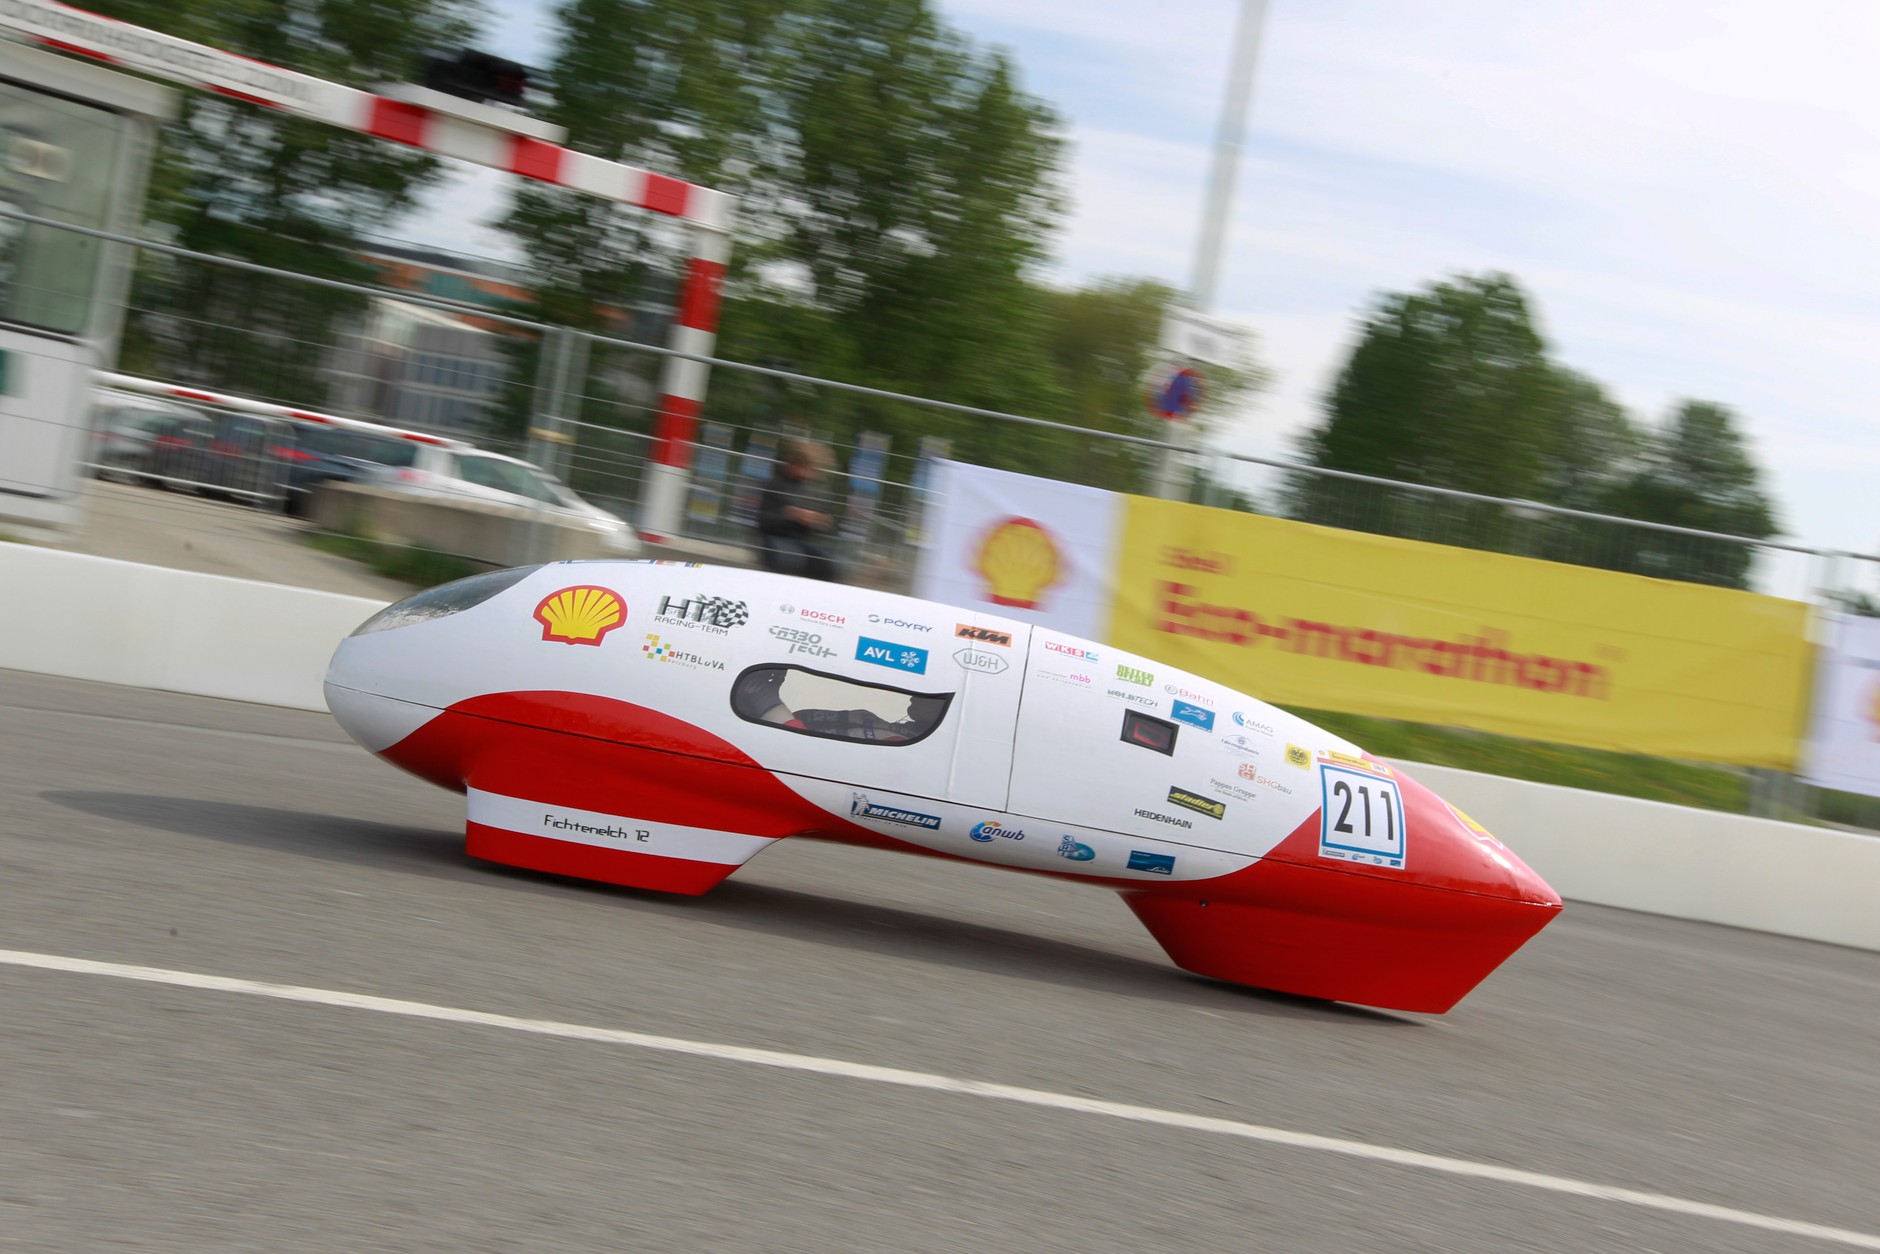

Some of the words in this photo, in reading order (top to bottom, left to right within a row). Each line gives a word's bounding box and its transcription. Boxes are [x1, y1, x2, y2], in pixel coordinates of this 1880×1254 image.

[654, 615, 729, 637] RACING-TEAM
[800, 609, 846, 625] BOSCH
[957, 627, 1010, 646] KTM
[863, 646, 895, 662] AVL
[963, 651, 999, 671] W&H
[1070, 672, 1091, 684] mbb
[1245, 719, 1274, 733] AMAG
[1256, 775, 1293, 795] SHGbau
[868, 807, 939, 827] MICHELIN
[1134, 808, 1193, 829] HEIDENHAIN
[1333, 780, 1395, 841] 211
[543, 814, 628, 840] Fichtenelch
[635, 829, 650, 843] 12
[982, 825, 1026, 841] anwb
